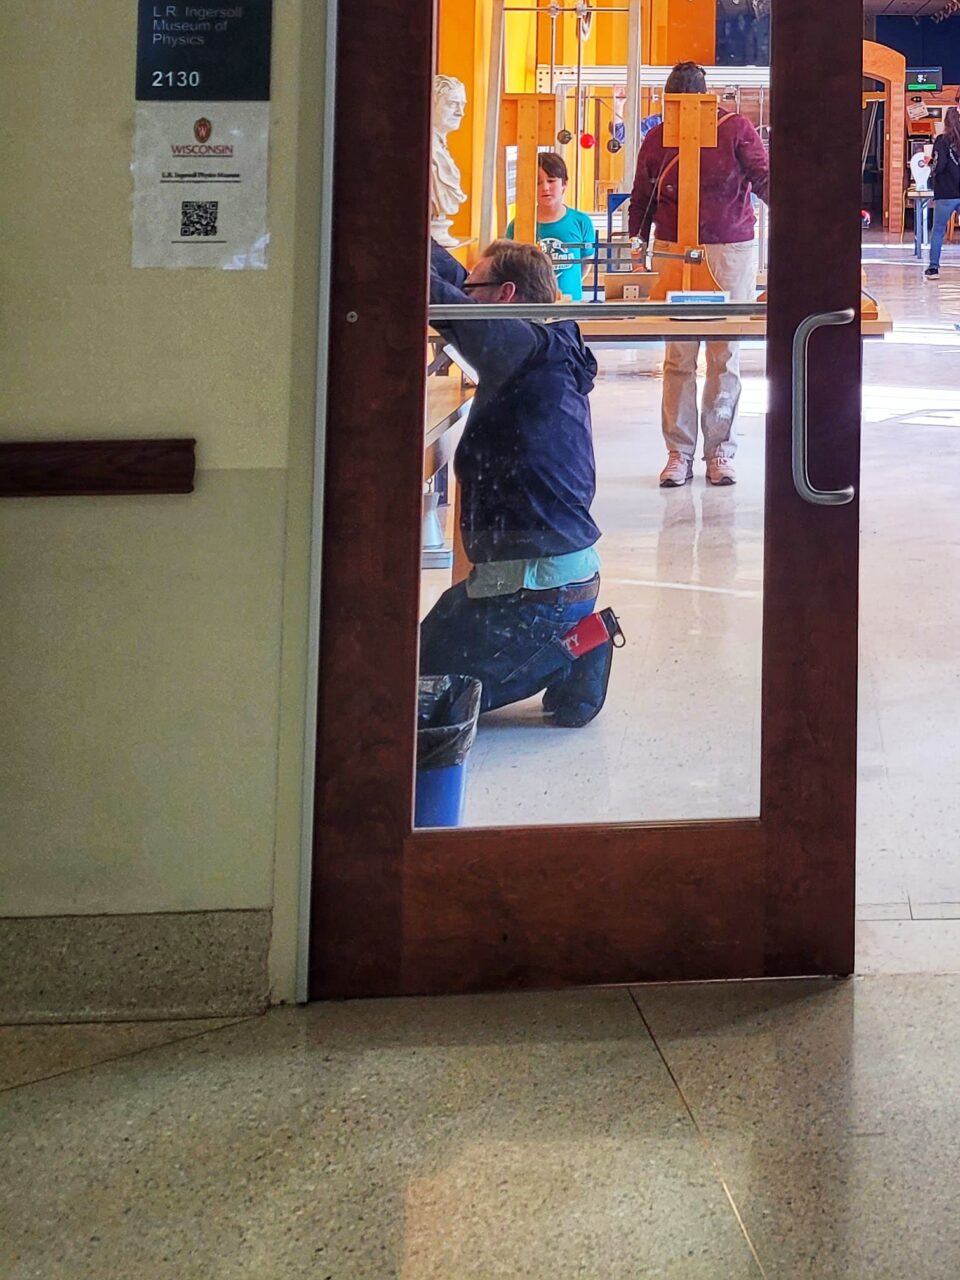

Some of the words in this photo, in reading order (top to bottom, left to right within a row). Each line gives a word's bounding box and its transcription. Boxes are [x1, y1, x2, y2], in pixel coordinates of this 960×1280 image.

[185, 6, 244, 21] Ingersoll
[152, 19, 211, 32] Museum
[214, 20, 229, 32] of
[152, 33, 206, 49] Physics
[151, 70, 201, 87] 2130
[171, 144, 234, 155] WISCONSIN
